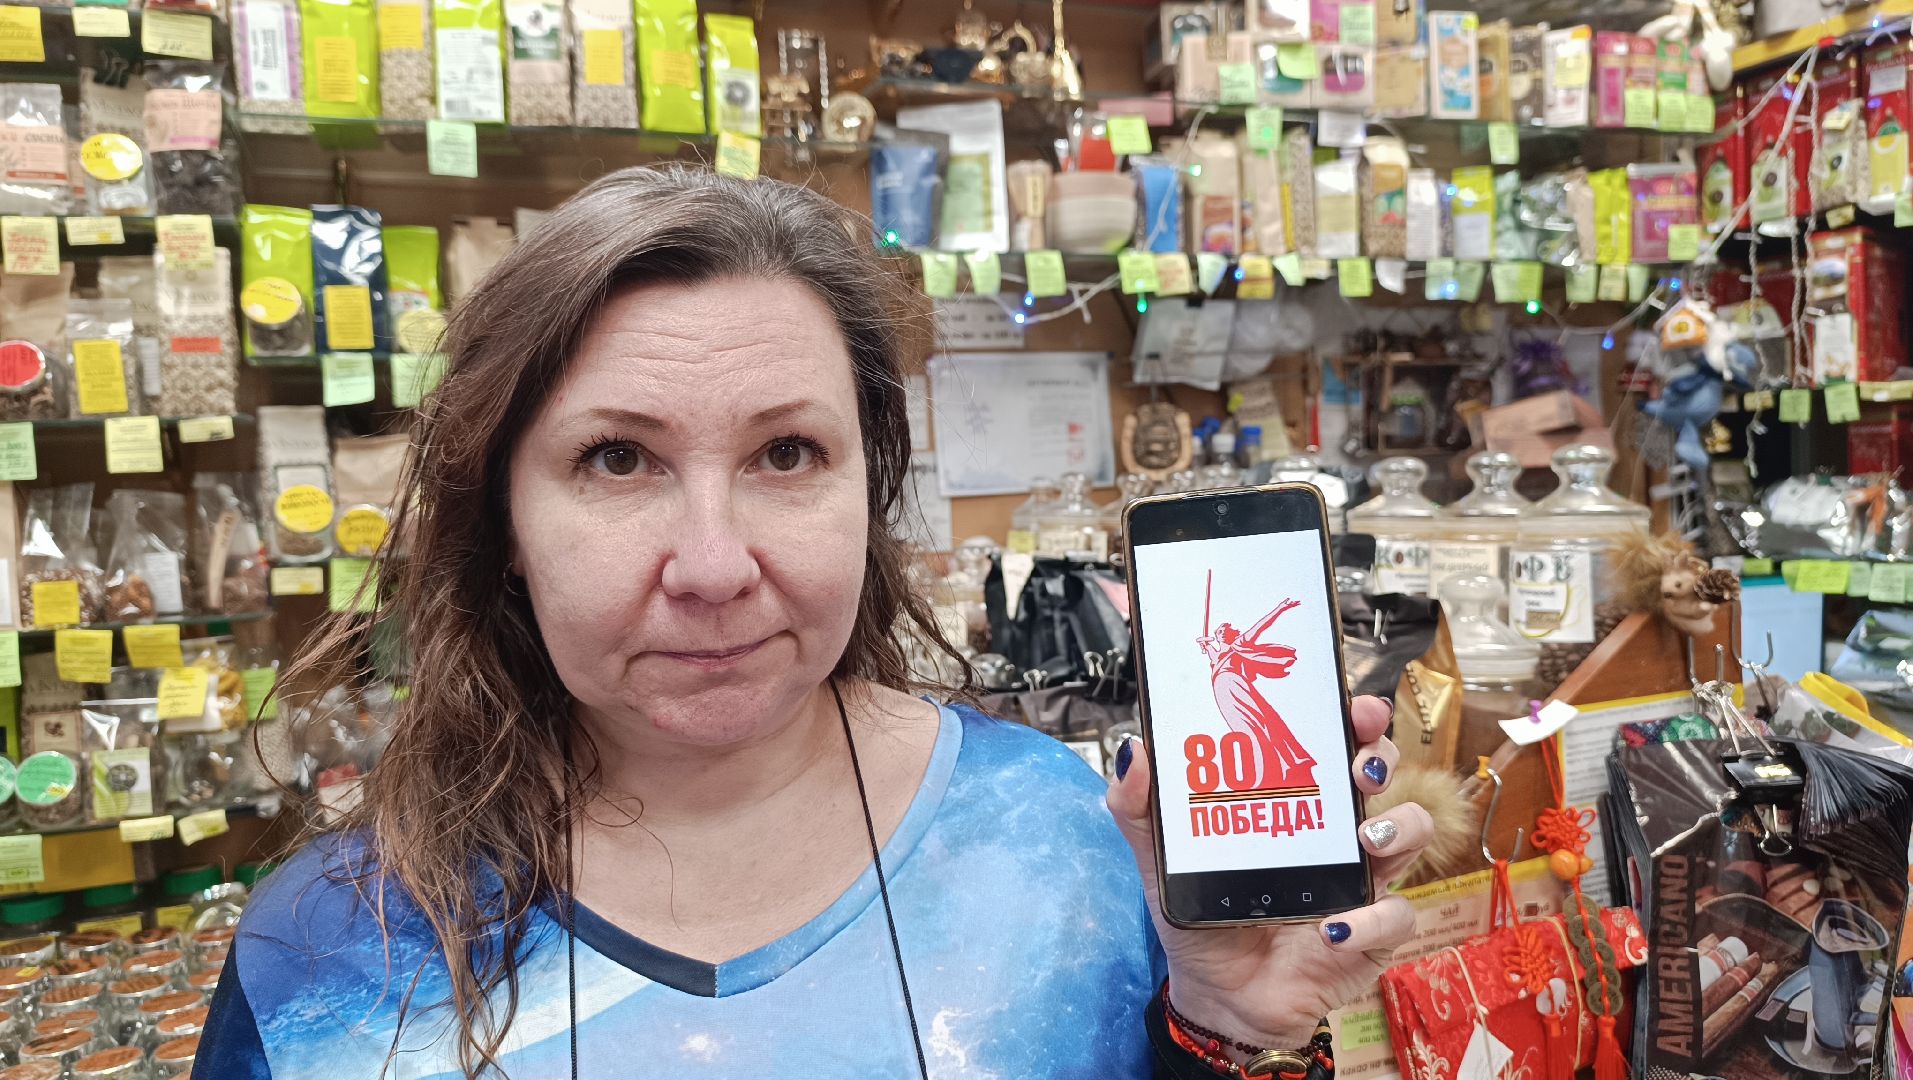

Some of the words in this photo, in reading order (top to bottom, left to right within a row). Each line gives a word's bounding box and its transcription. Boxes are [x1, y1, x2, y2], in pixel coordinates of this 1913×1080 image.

[1184, 731, 1257, 793] 80
[1190, 799, 1325, 837] ПОБЕДА!
[1656, 854, 1694, 1058] AMERICANO
